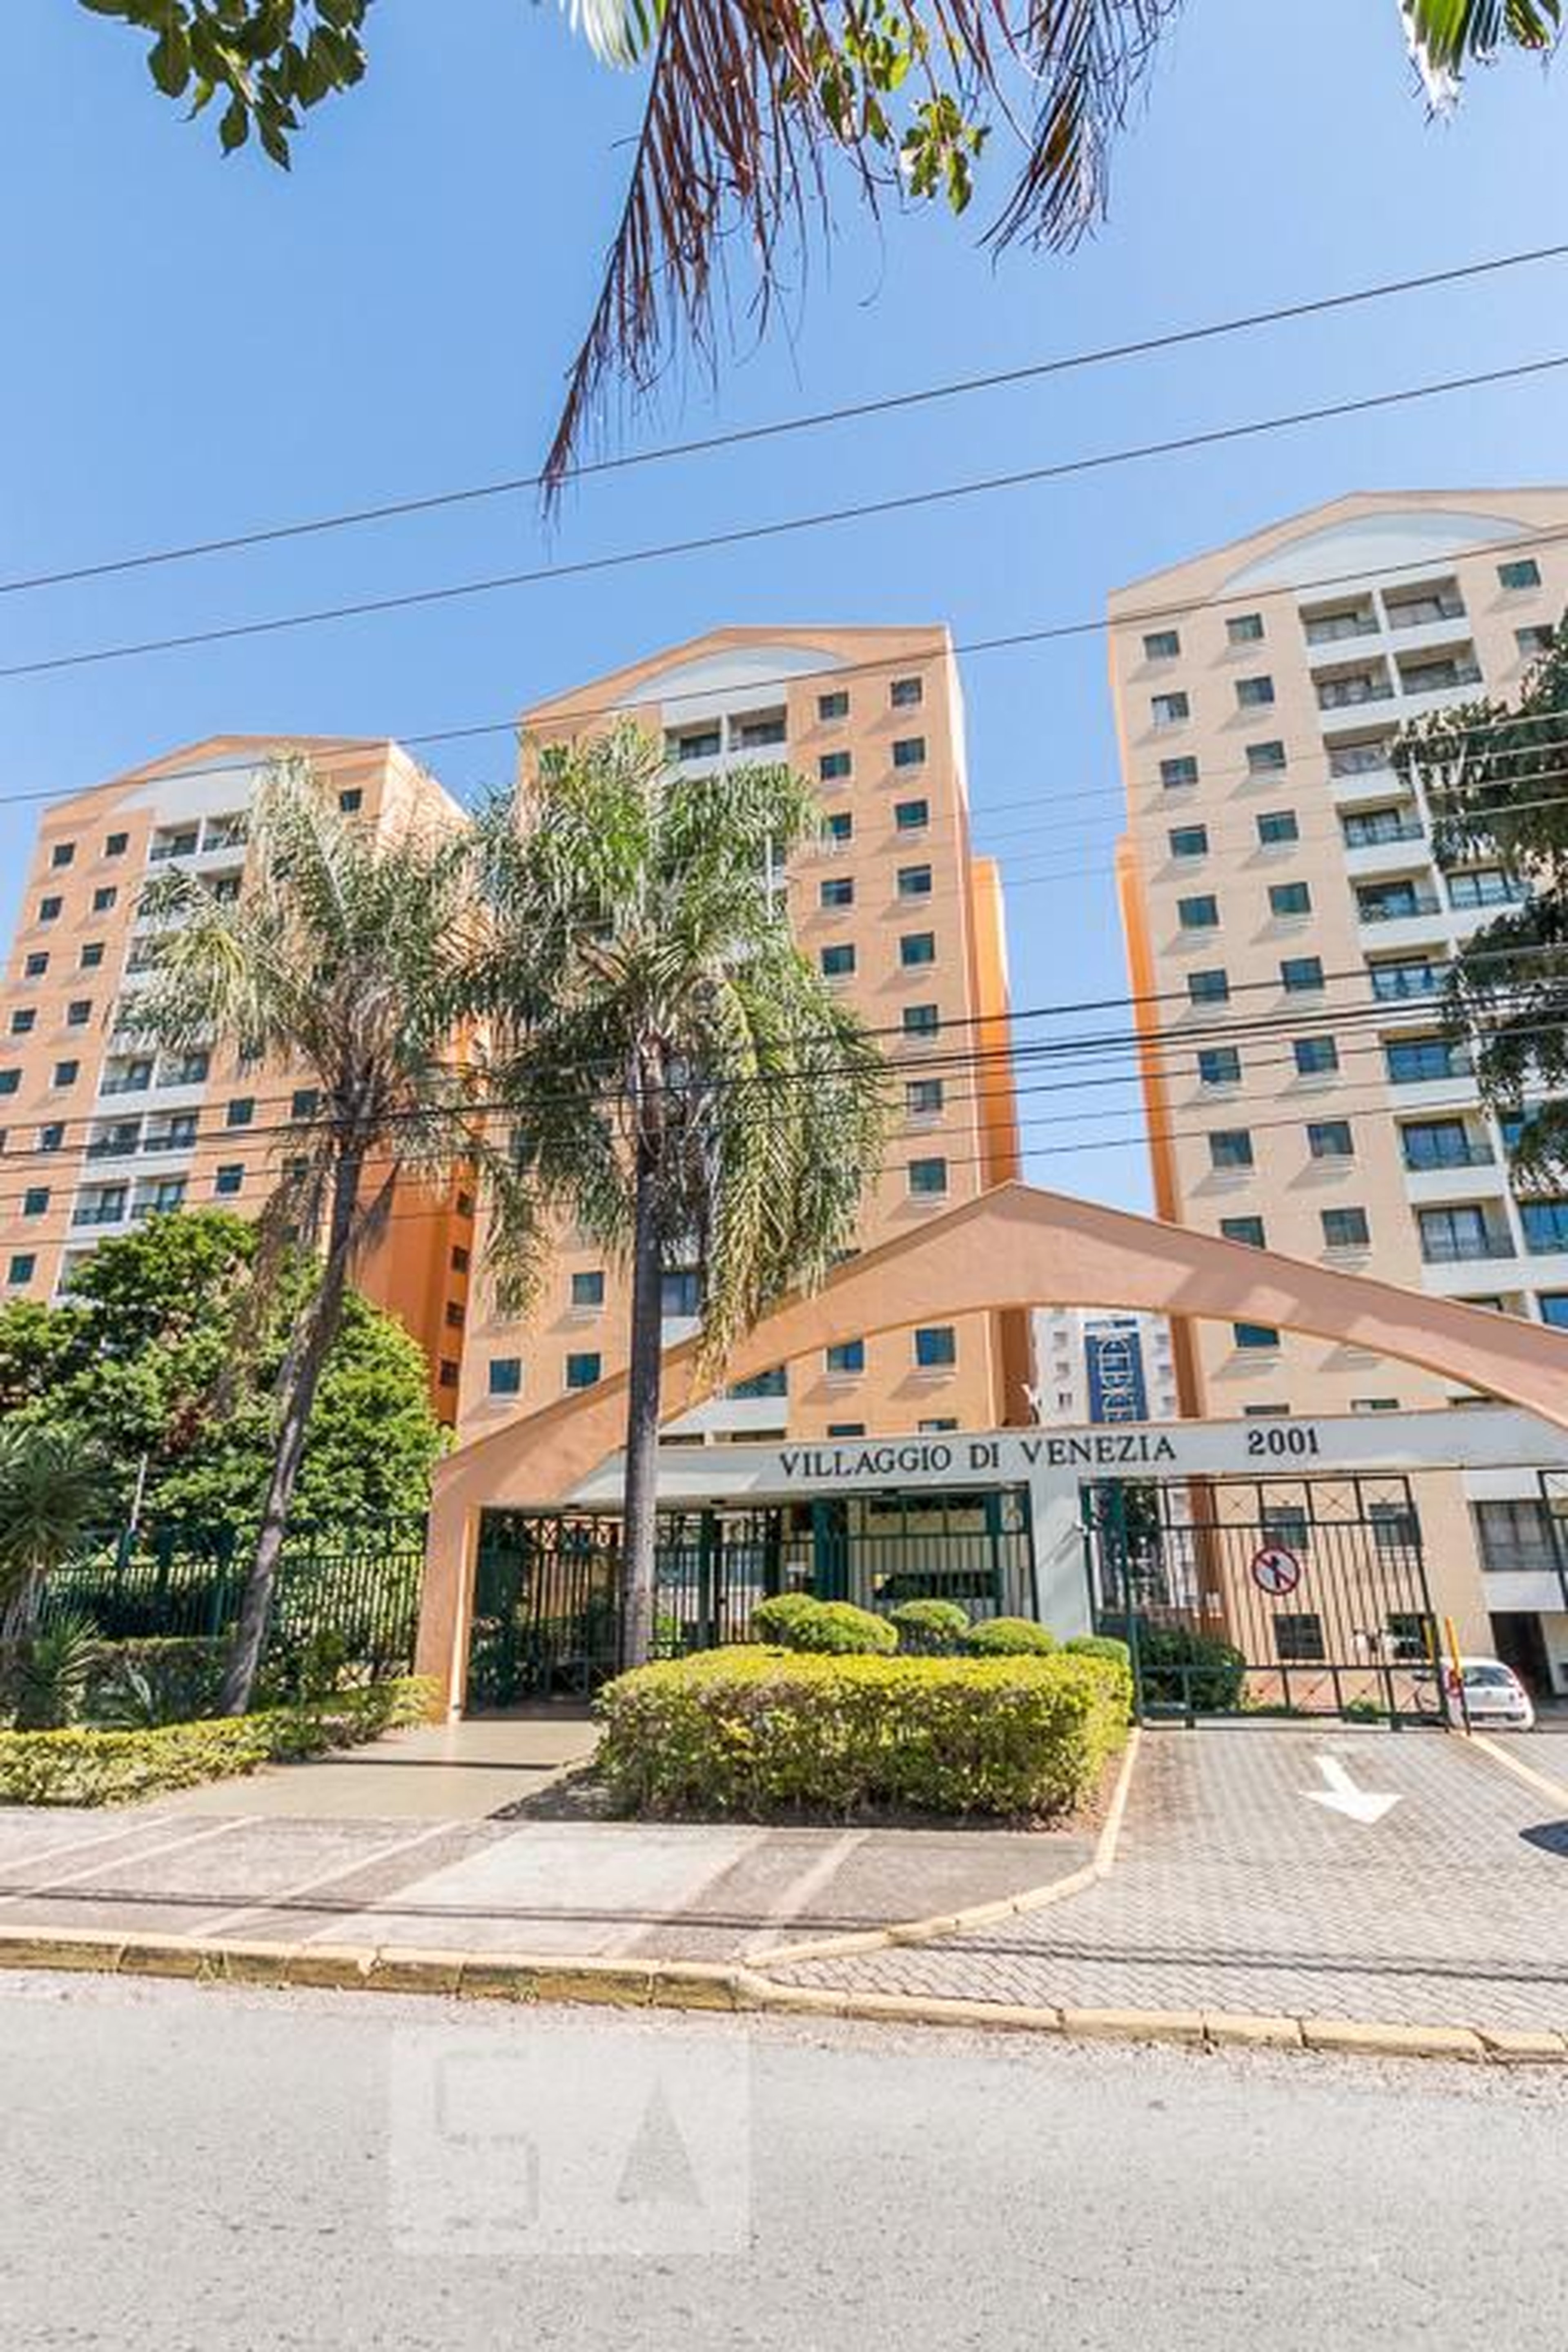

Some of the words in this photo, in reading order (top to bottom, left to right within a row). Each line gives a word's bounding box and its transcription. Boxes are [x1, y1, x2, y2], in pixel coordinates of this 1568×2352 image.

[780, 1445, 951, 1477] VILLAGGIO
[969, 1442, 1000, 1470] DI
[1020, 1435, 1176, 1466] VENEZIA
[1247, 1427, 1319, 1456] 2001
